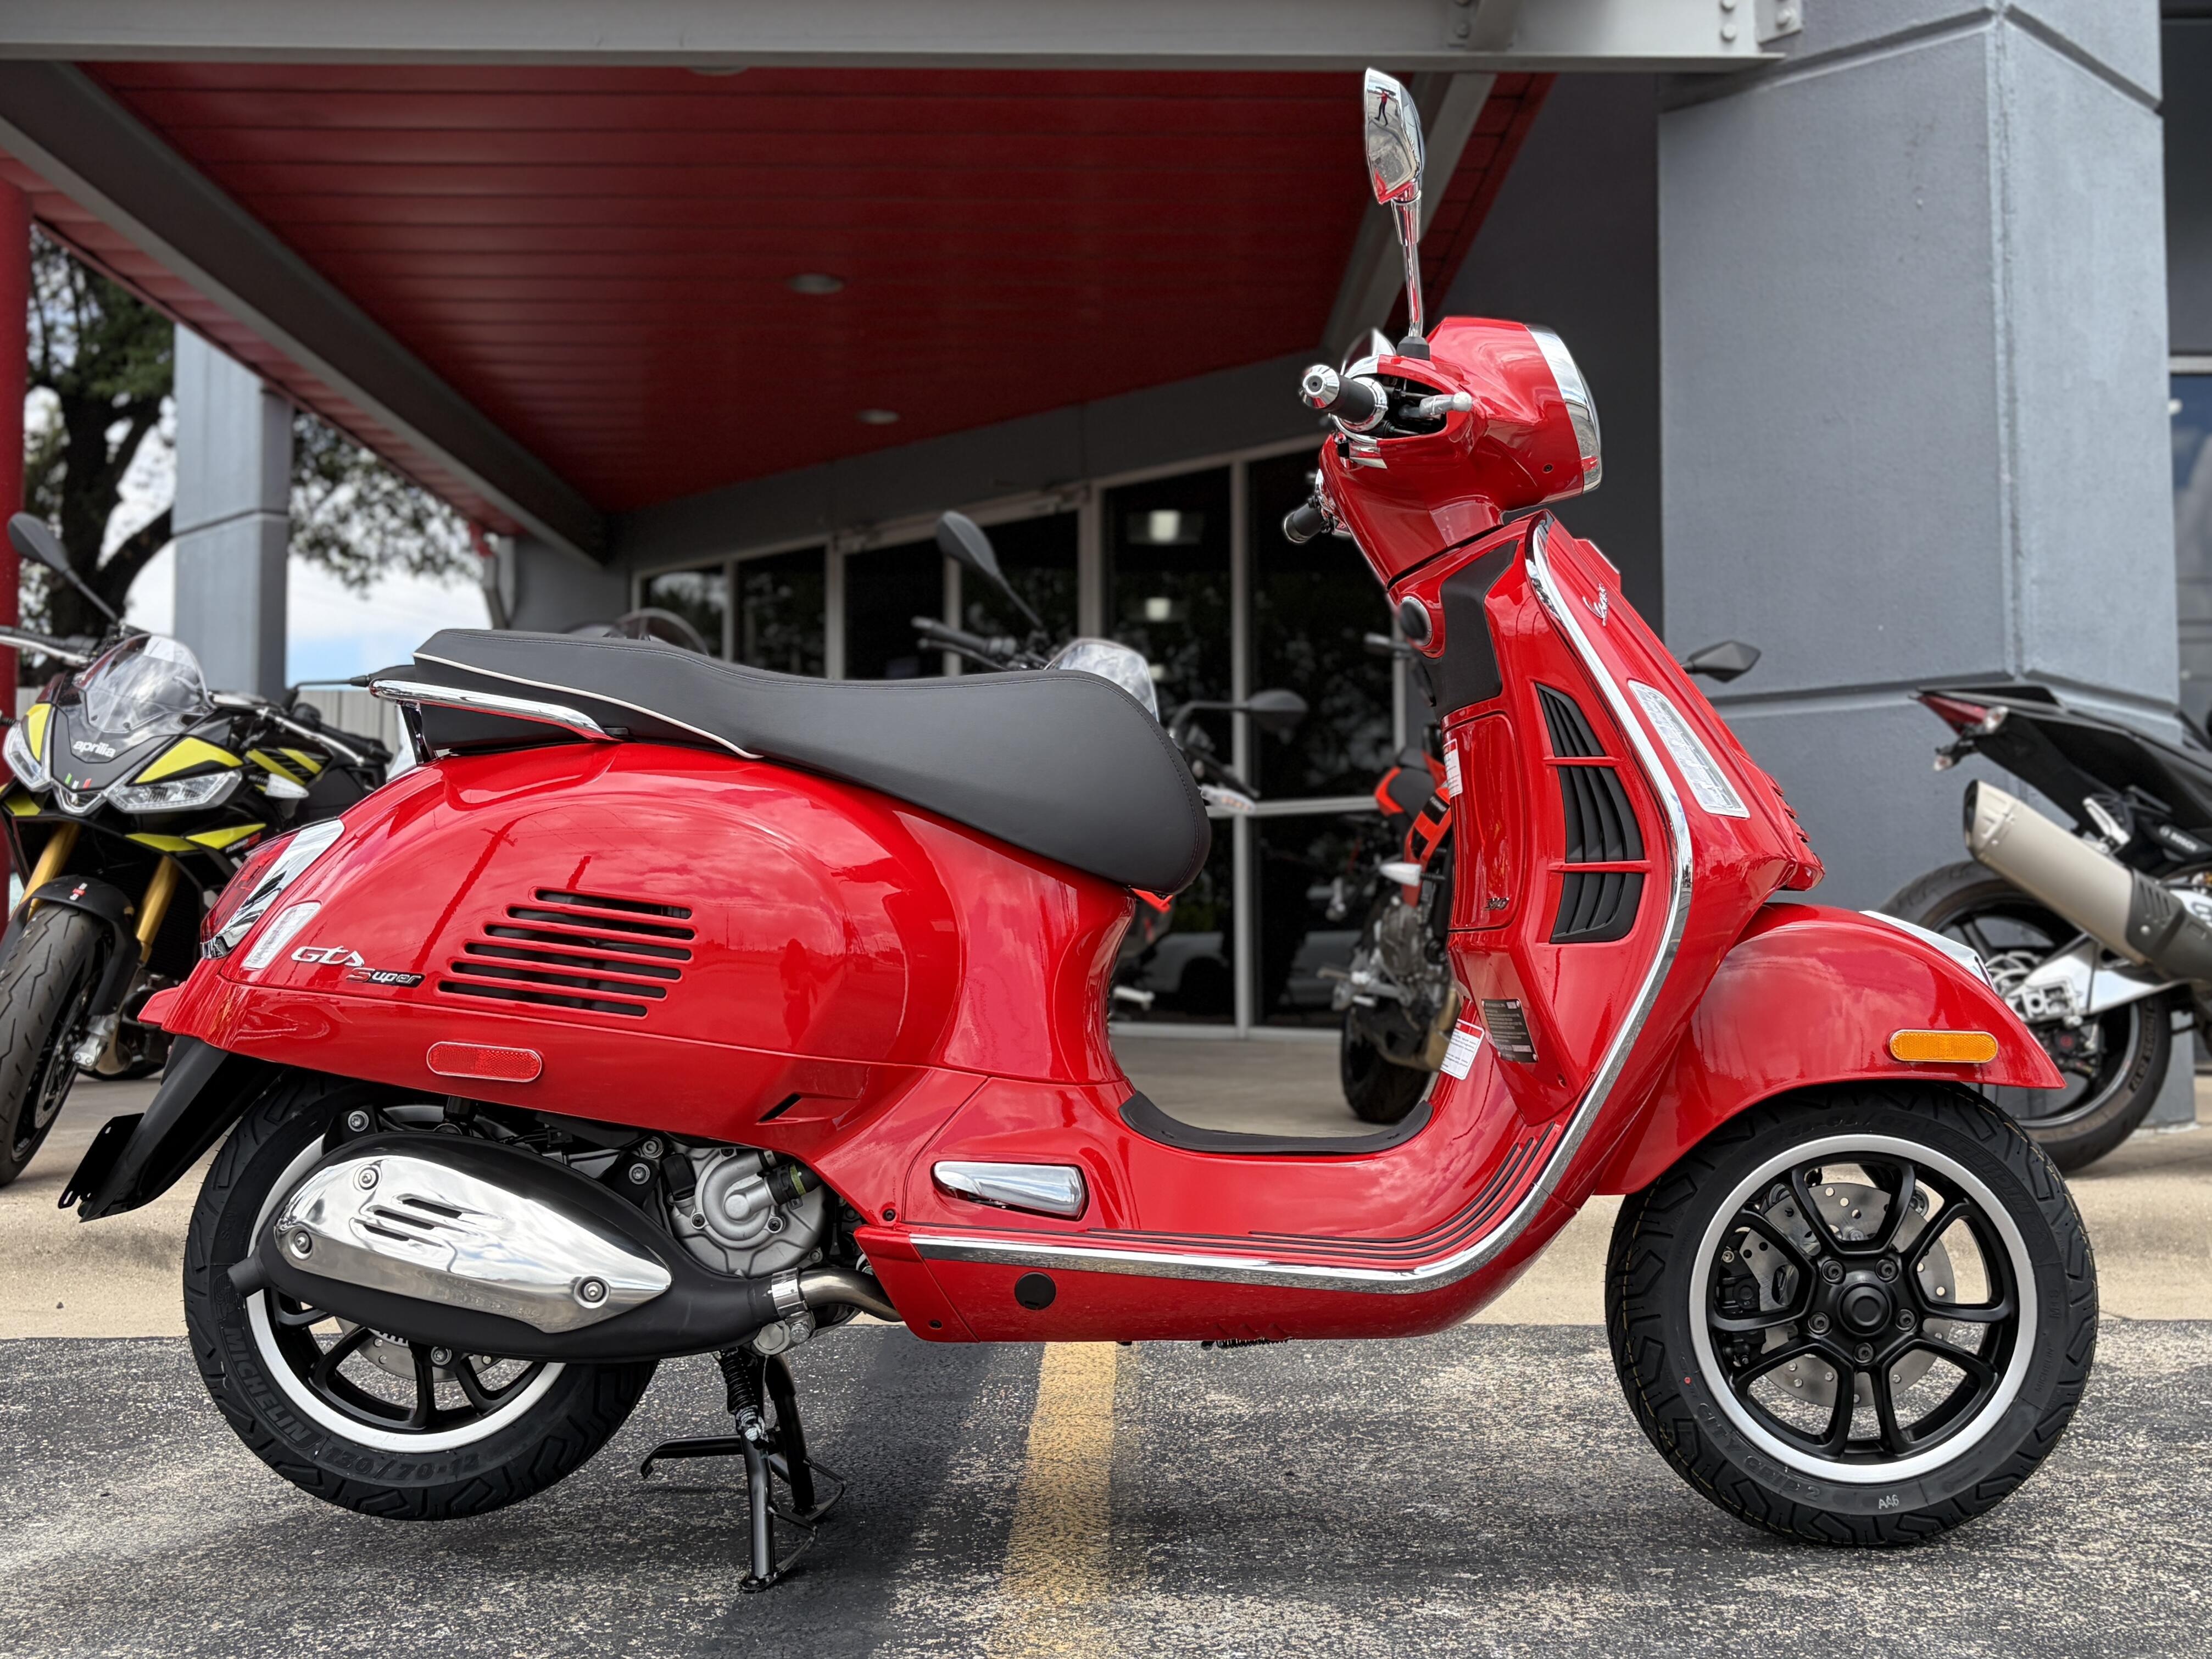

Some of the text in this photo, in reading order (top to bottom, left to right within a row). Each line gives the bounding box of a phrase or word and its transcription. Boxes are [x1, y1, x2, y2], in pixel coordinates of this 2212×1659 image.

[73, 741, 116, 758] aprilia
[2170, 832, 2197, 851] BOSCH
[346, 967, 421, 985] Super
[2034, 1346, 2054, 1393] MICHELIN
[224, 1327, 307, 1442] MICHELIN
[324, 1446, 480, 1480] 130/70-12
[1695, 1400, 1821, 1502] CITY GRIP 2
[1878, 1494, 1899, 1510] AA6
